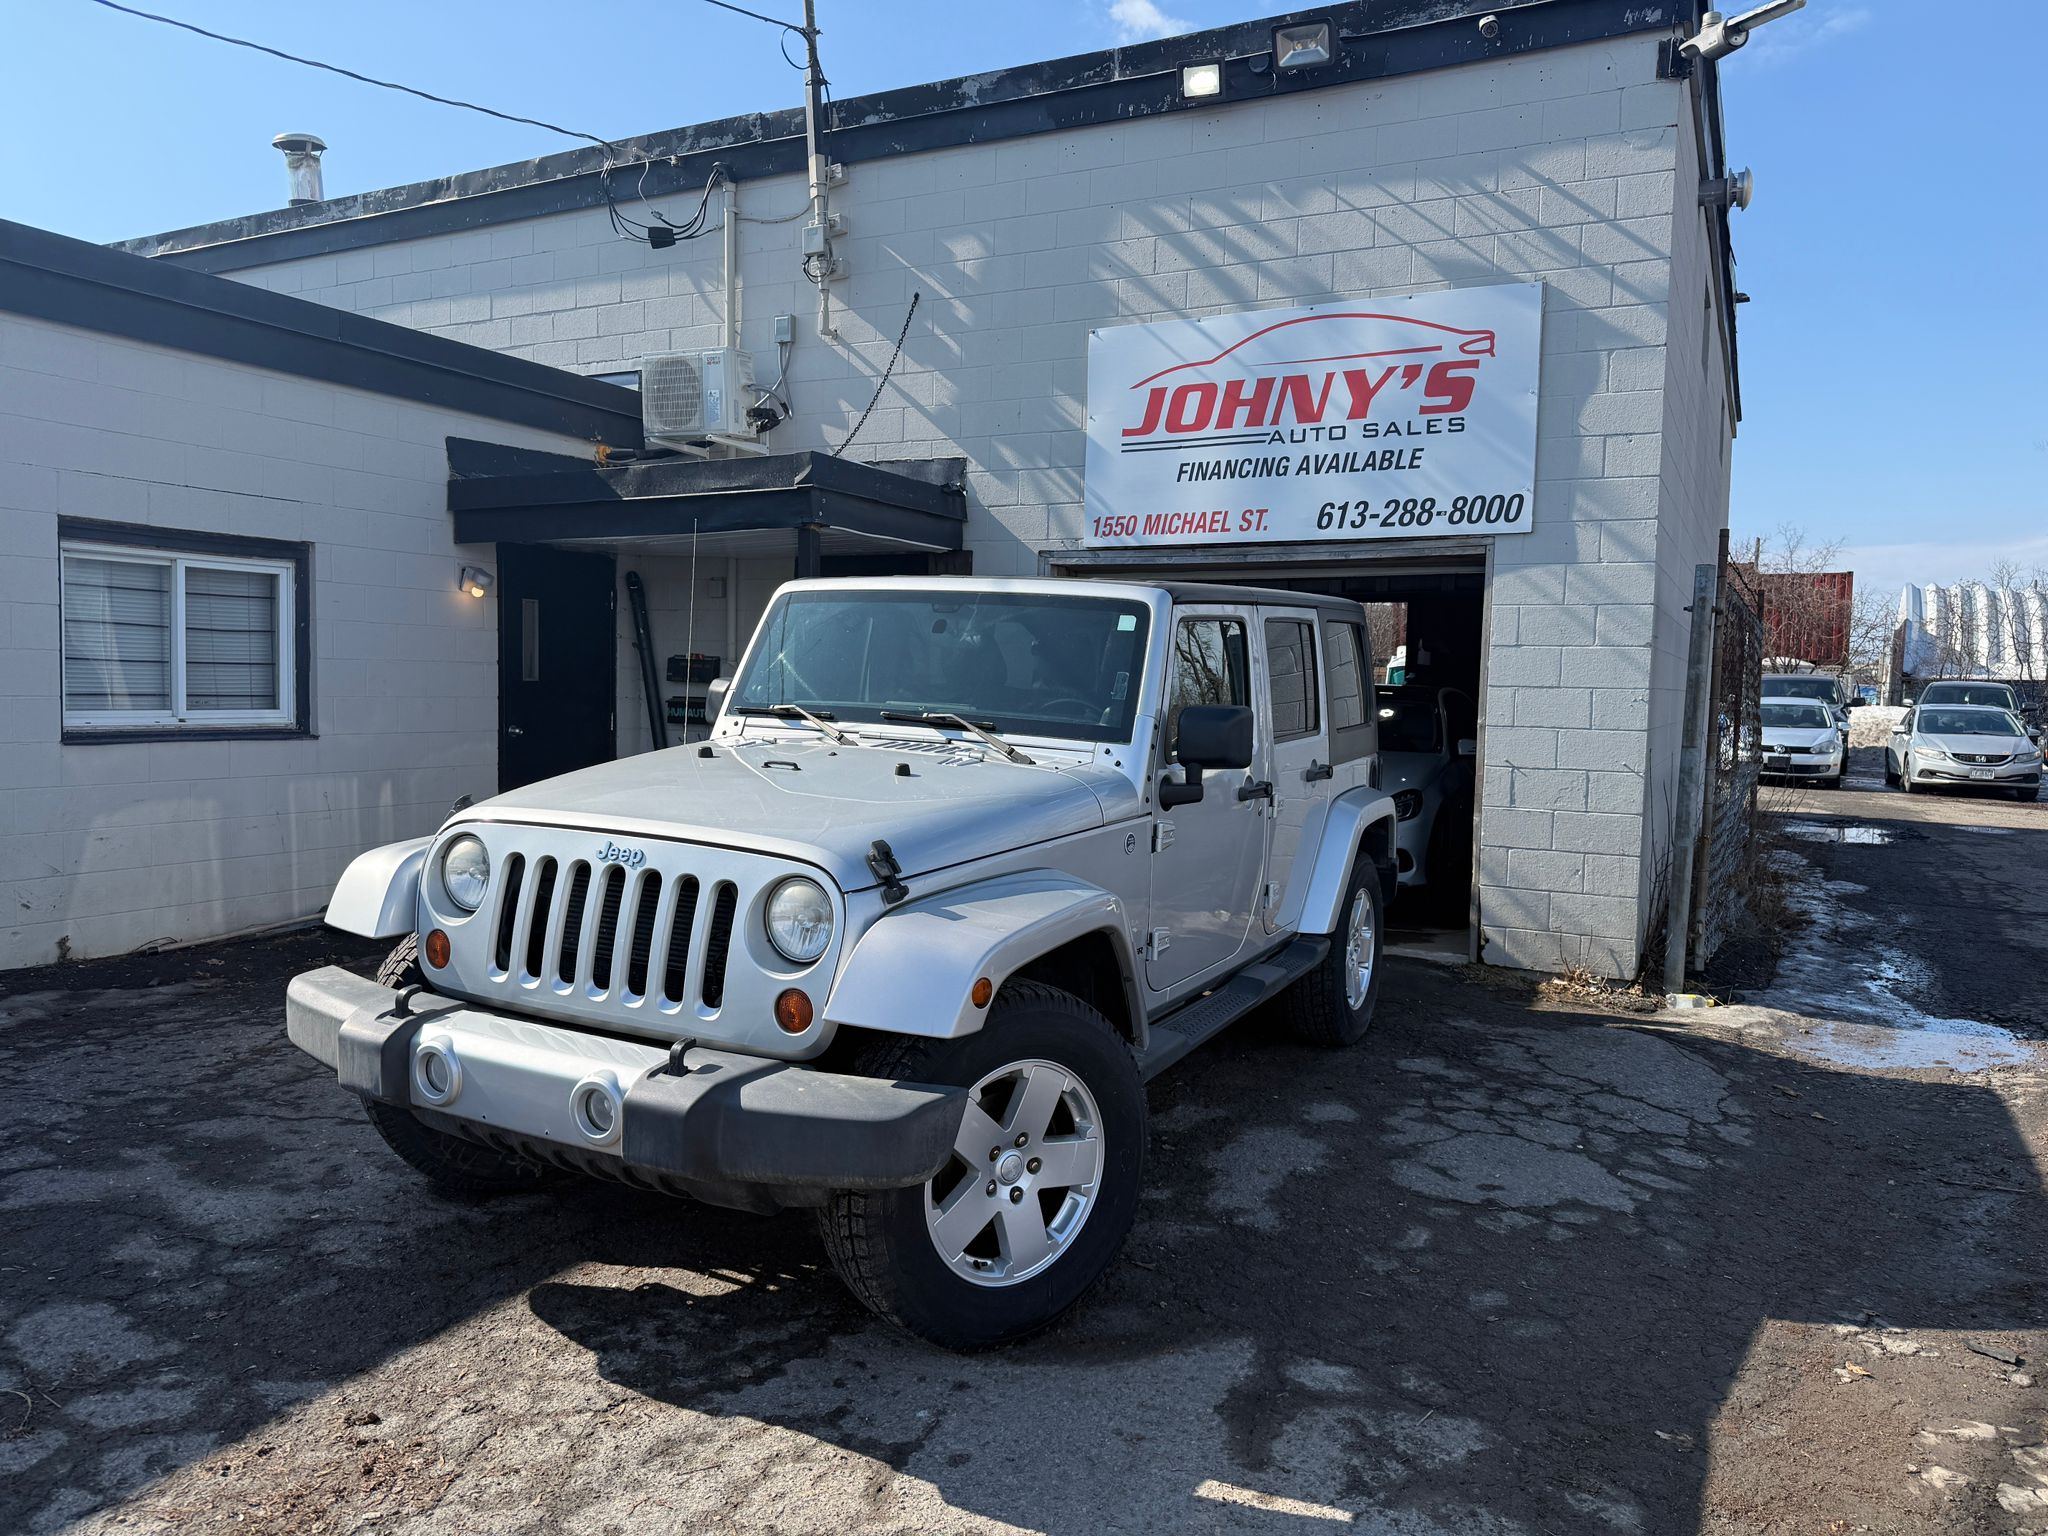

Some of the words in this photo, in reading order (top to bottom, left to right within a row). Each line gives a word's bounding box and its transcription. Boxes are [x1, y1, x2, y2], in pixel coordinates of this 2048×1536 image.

[1121, 358, 1480, 438] JOHNY'S
[1267, 424, 1347, 446] AUTO
[1362, 416, 1466, 439] SALES
[1176, 456, 1290, 483] FINANCING
[1295, 447, 1425, 476] AVAILABLE
[1092, 515, 1138, 538] 1550
[1142, 510, 1232, 536] MICHAEL
[1238, 508, 1269, 532] ST.
[1316, 493, 1525, 530] 613-288-8000
[596, 840, 647, 871] Jeep
